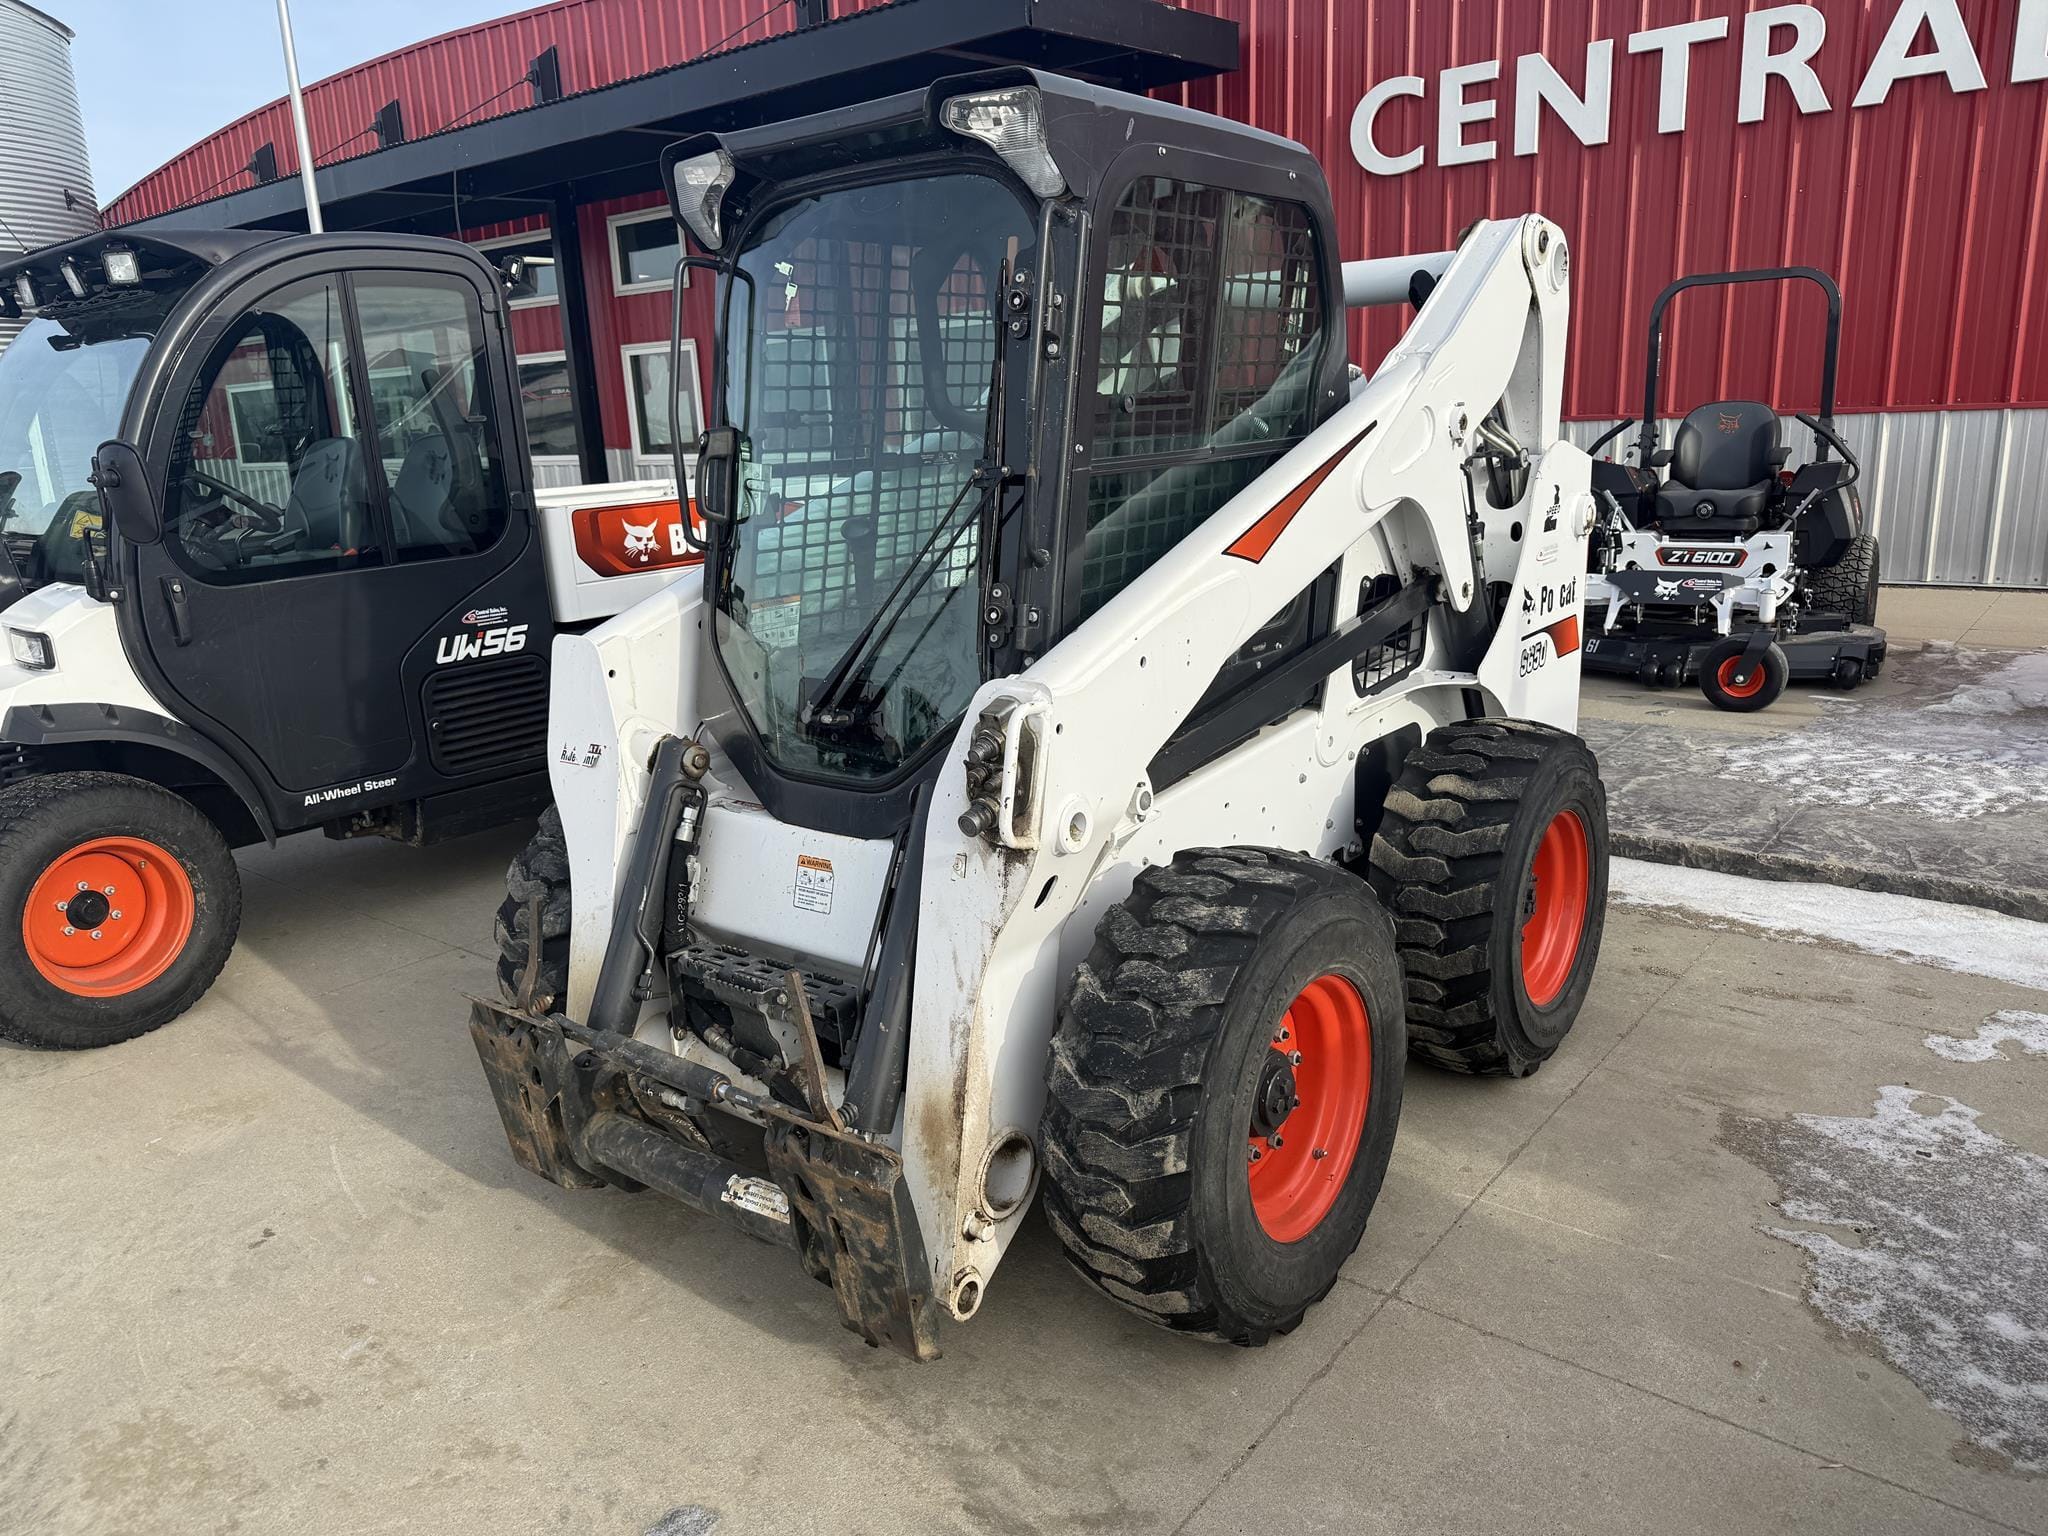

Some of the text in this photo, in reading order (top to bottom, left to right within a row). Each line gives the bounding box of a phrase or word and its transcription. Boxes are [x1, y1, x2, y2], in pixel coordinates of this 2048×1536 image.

[1667, 550, 1735, 564] ZT6100
[1585, 638, 1601, 654] 61
[304, 777, 397, 807] All-Wheel Steer
